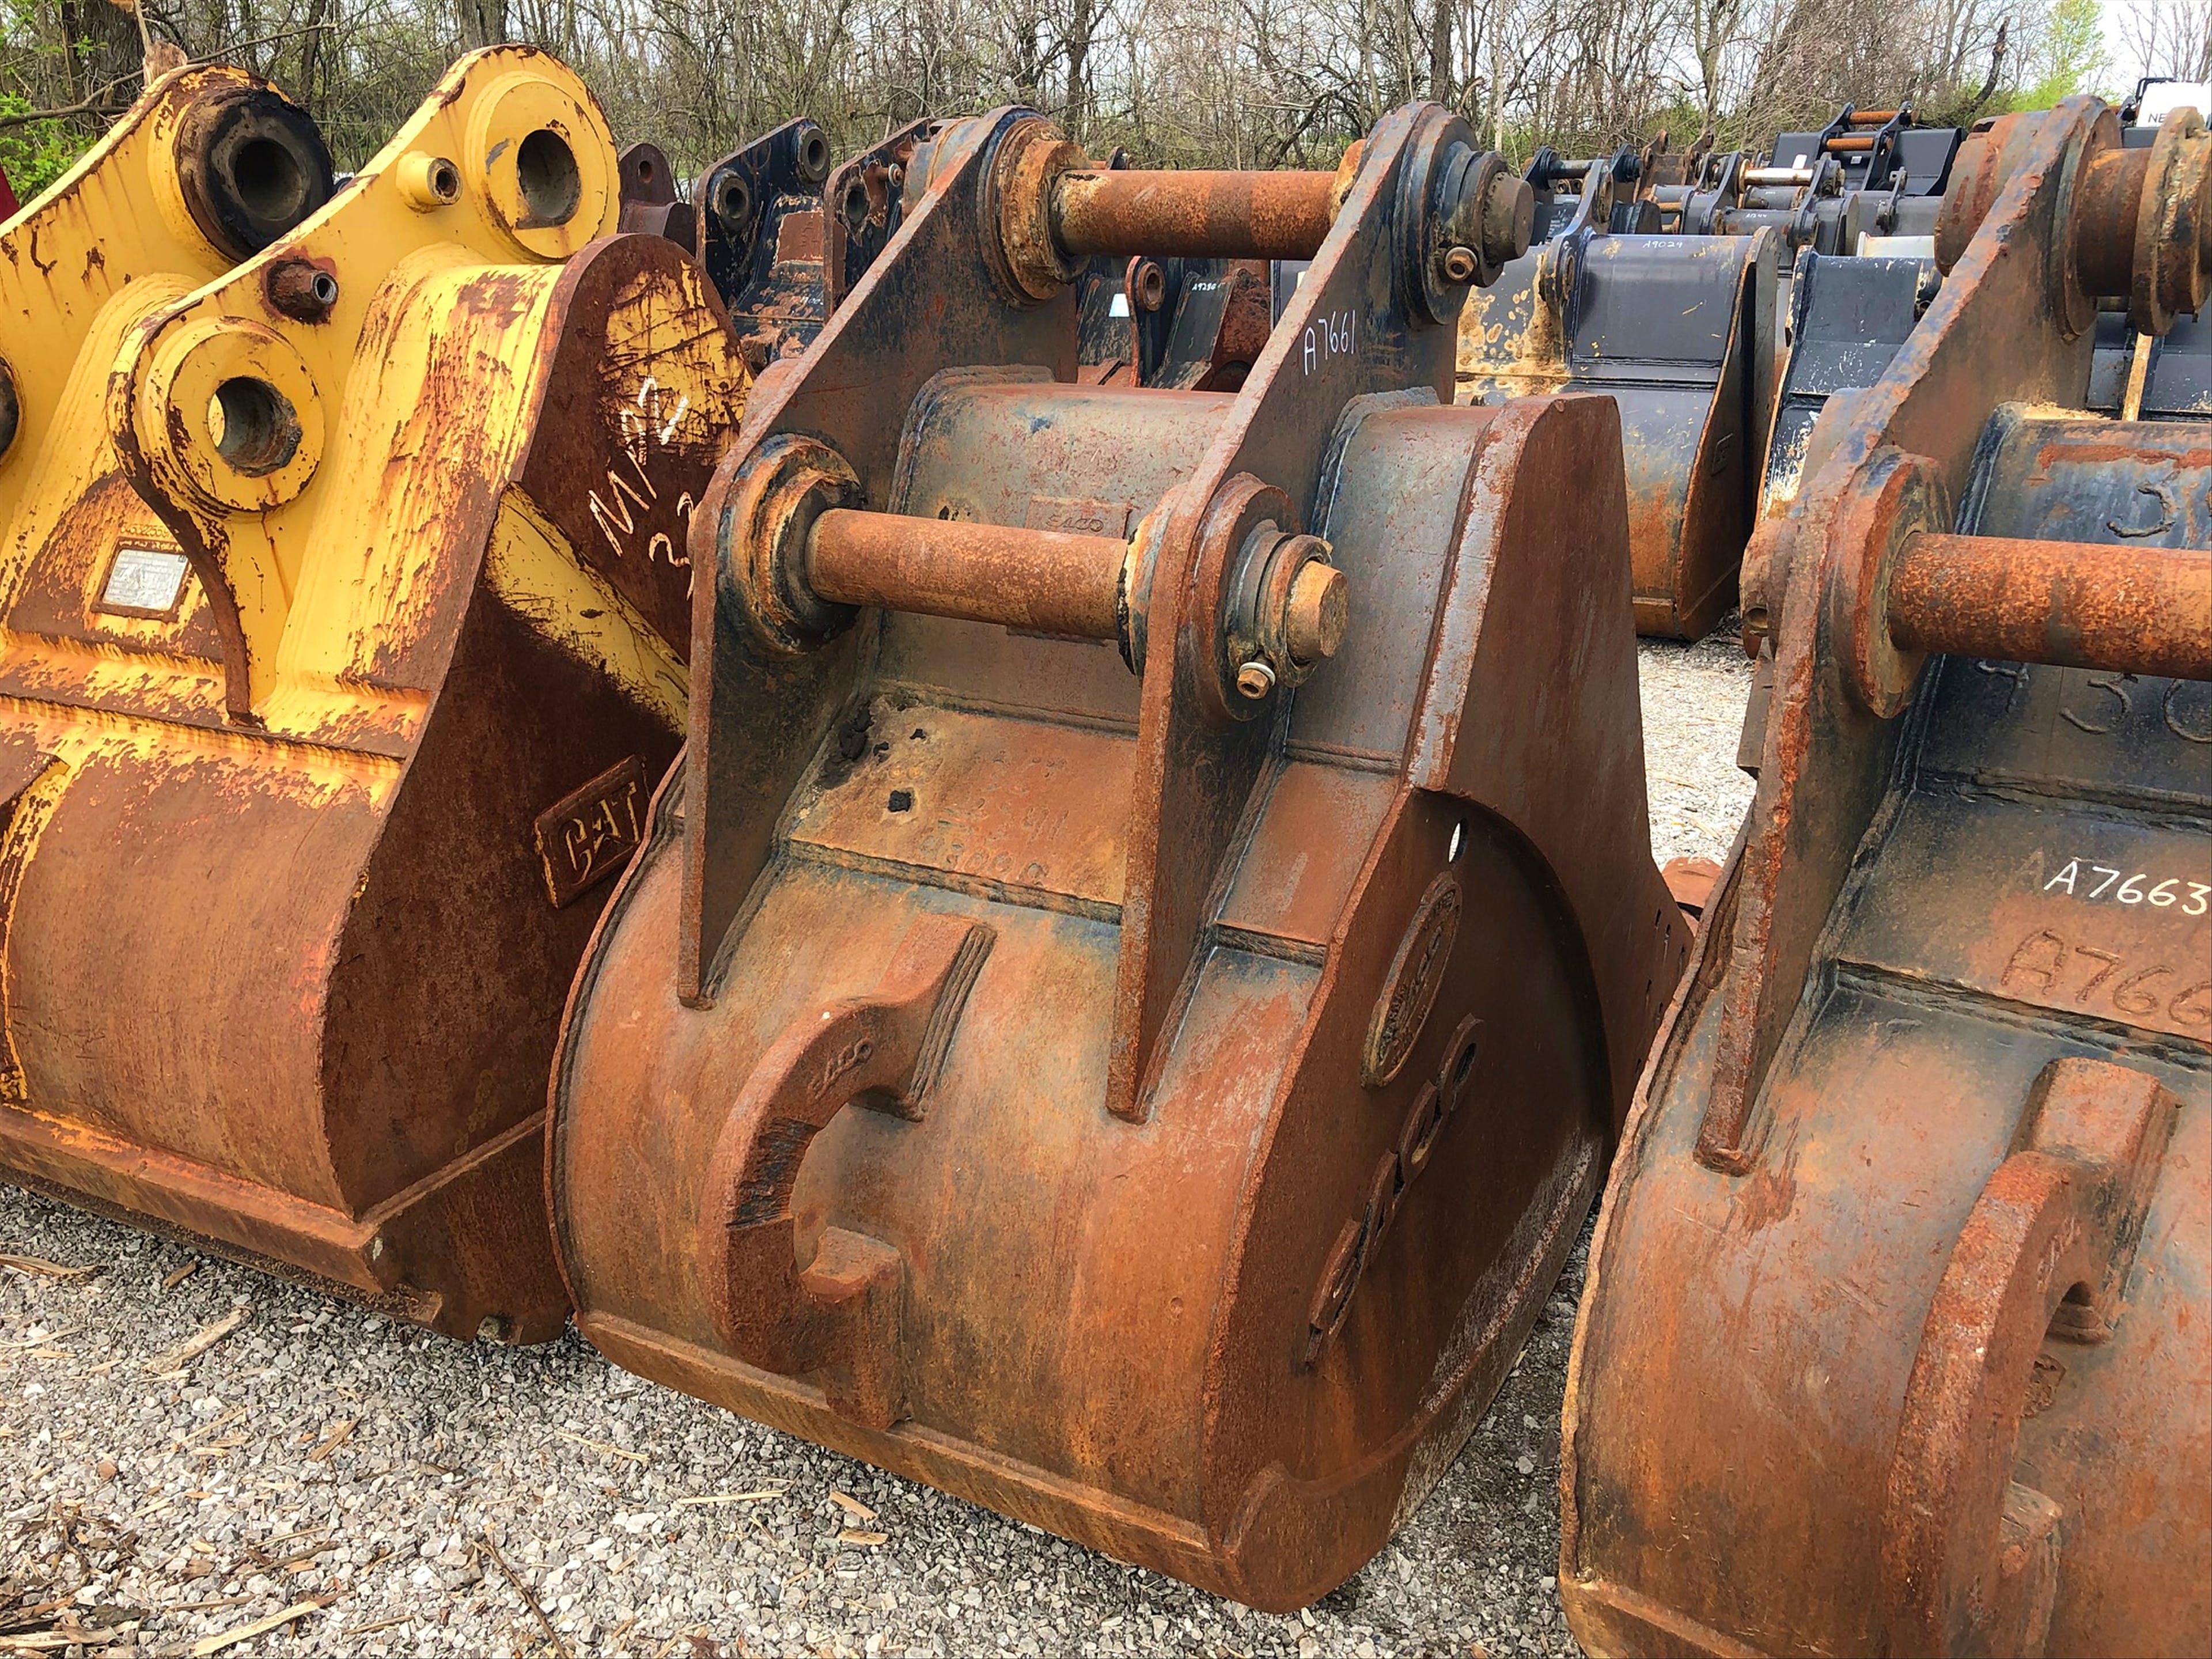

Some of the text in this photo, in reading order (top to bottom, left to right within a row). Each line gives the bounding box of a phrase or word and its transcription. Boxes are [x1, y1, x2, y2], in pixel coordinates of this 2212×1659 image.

[1642, 240, 1683, 248] A9024
[1304, 309, 1355, 376] A7661
[564, 781, 641, 886] CAT
[2044, 859, 2211, 915] A7663
